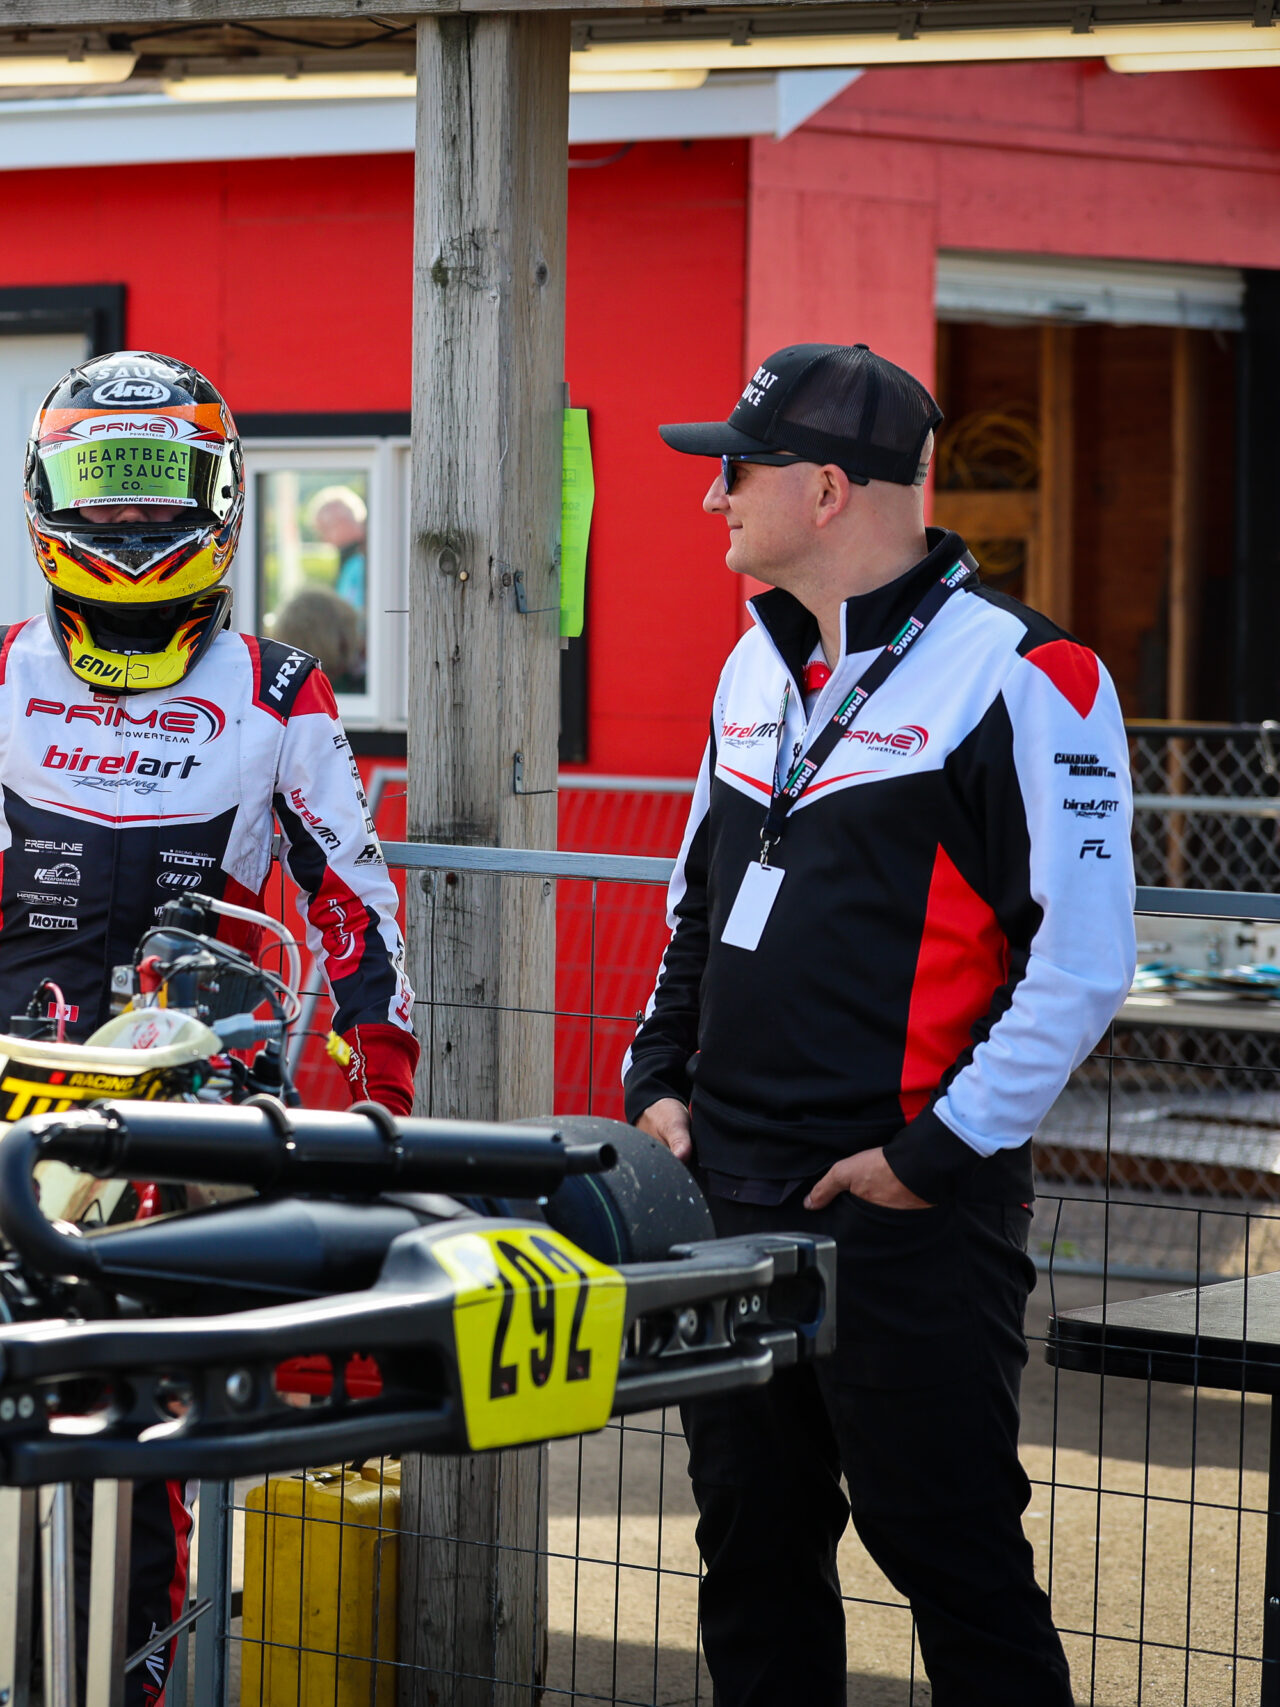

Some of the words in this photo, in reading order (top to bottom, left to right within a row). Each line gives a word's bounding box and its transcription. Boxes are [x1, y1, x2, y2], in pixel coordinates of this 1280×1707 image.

[104, 381, 163, 399] Arai
[89, 422, 167, 436] PRIME
[77, 447, 189, 465] HEARTBEAT
[79, 465, 116, 482] HOT
[123, 464, 186, 482] SAUCE
[121, 481, 144, 490] CO.
[892, 625, 919, 656] RMC
[269, 651, 307, 701] HRX
[26, 698, 198, 734] PRIME
[838, 694, 866, 727] RMC
[115, 731, 190, 744] POWERTEAM
[842, 730, 916, 750] PRIME
[41, 744, 202, 780] birelart
[65, 773, 173, 795] Racing
[788, 766, 816, 798] RMC
[1063, 798, 1119, 812] birelART
[24, 839, 83, 851] FREELINE
[159, 851, 216, 868] TILLETT
[17, 892, 62, 902] HAMILTON
[31, 914, 76, 928] MOTUL
[70, 1073, 134, 1091] RACING
[455, 1235, 592, 1401] 292
